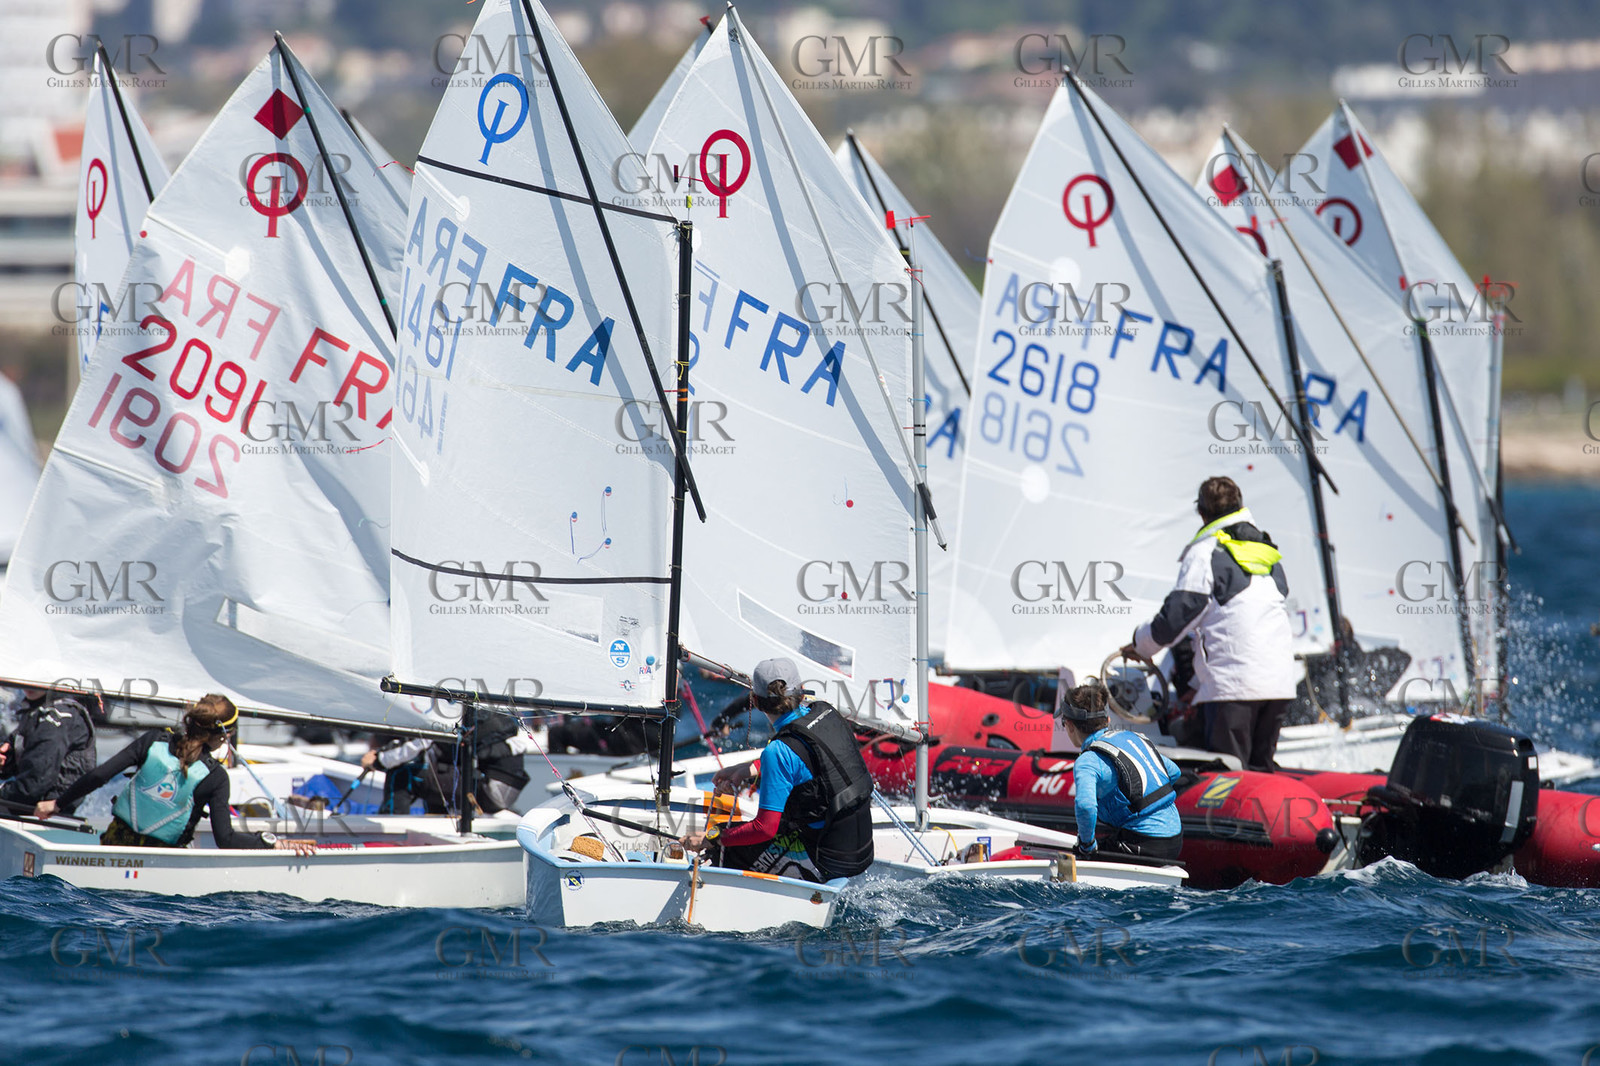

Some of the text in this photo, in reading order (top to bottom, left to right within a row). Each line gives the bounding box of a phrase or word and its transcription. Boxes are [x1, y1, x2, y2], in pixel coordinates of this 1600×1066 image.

[489, 262, 615, 387] FRA
[724, 289, 846, 407] FRA
[1109, 309, 1228, 393] FRA
[289, 327, 392, 430] FR
[987, 330, 1100, 414] 2618
[56, 856, 144, 868] WINNER TEAM
